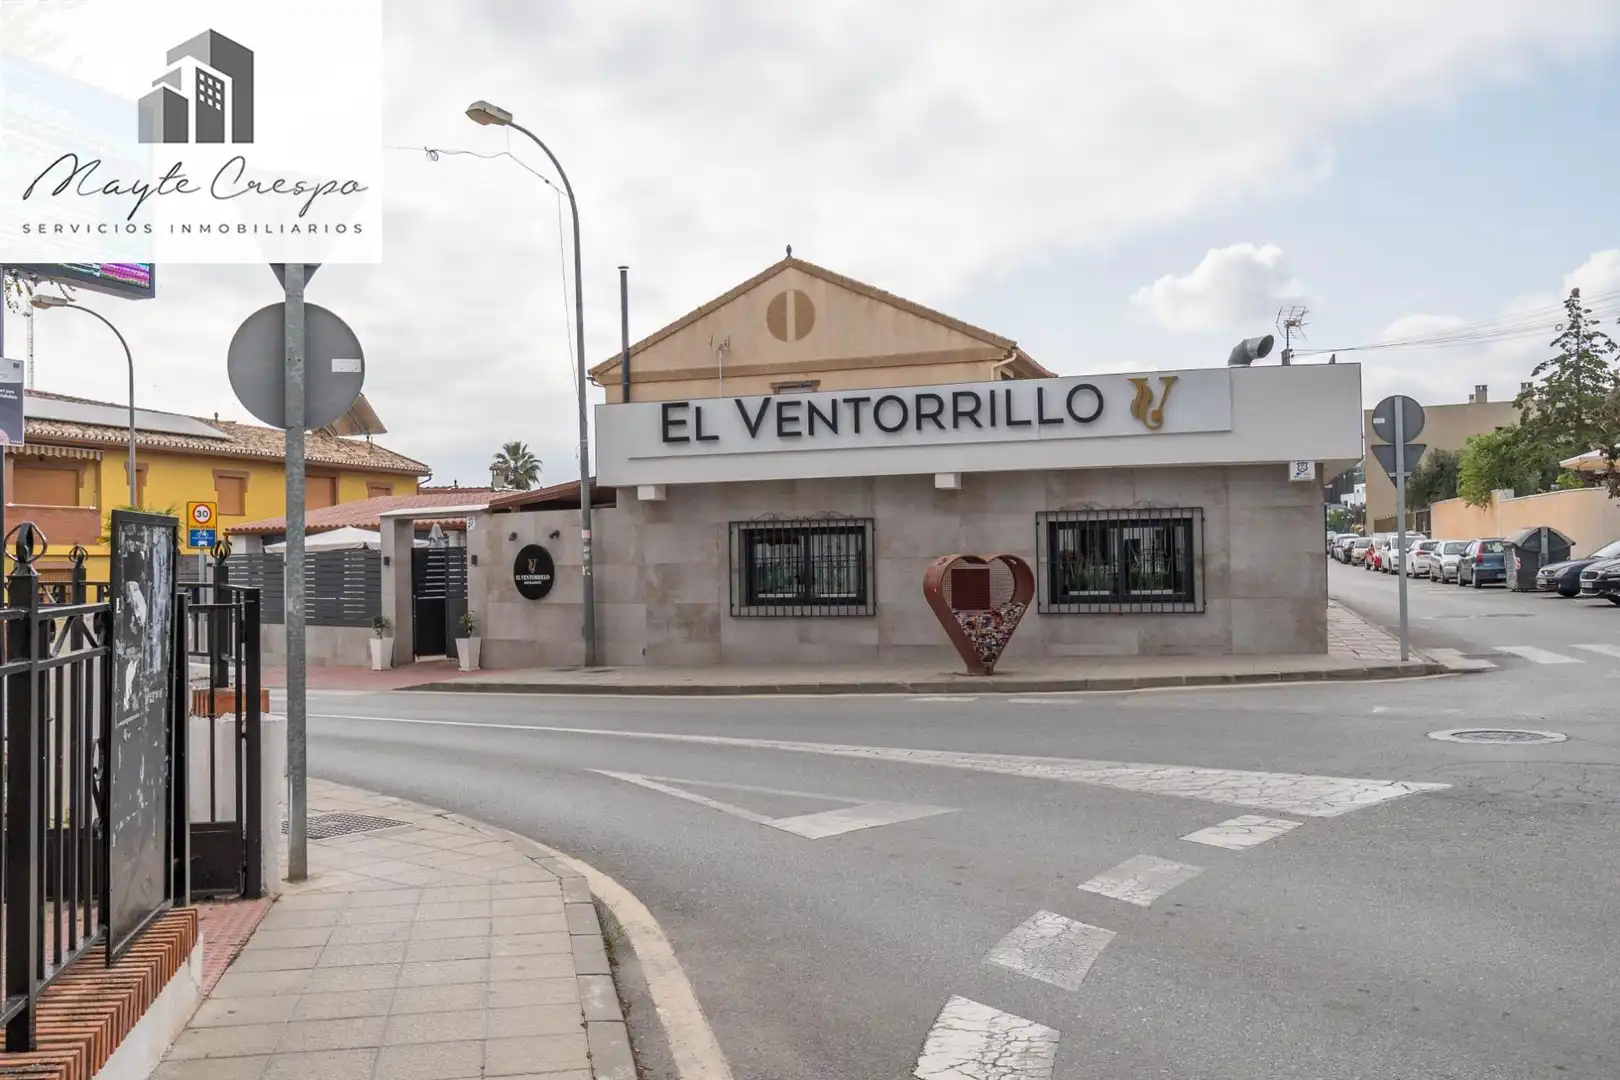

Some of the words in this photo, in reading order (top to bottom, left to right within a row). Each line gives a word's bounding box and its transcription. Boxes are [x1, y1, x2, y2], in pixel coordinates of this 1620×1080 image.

[661, 401, 720, 443] EL
[734, 383, 1104, 439] VENTORRILLO
[196, 510, 208, 518] 30
